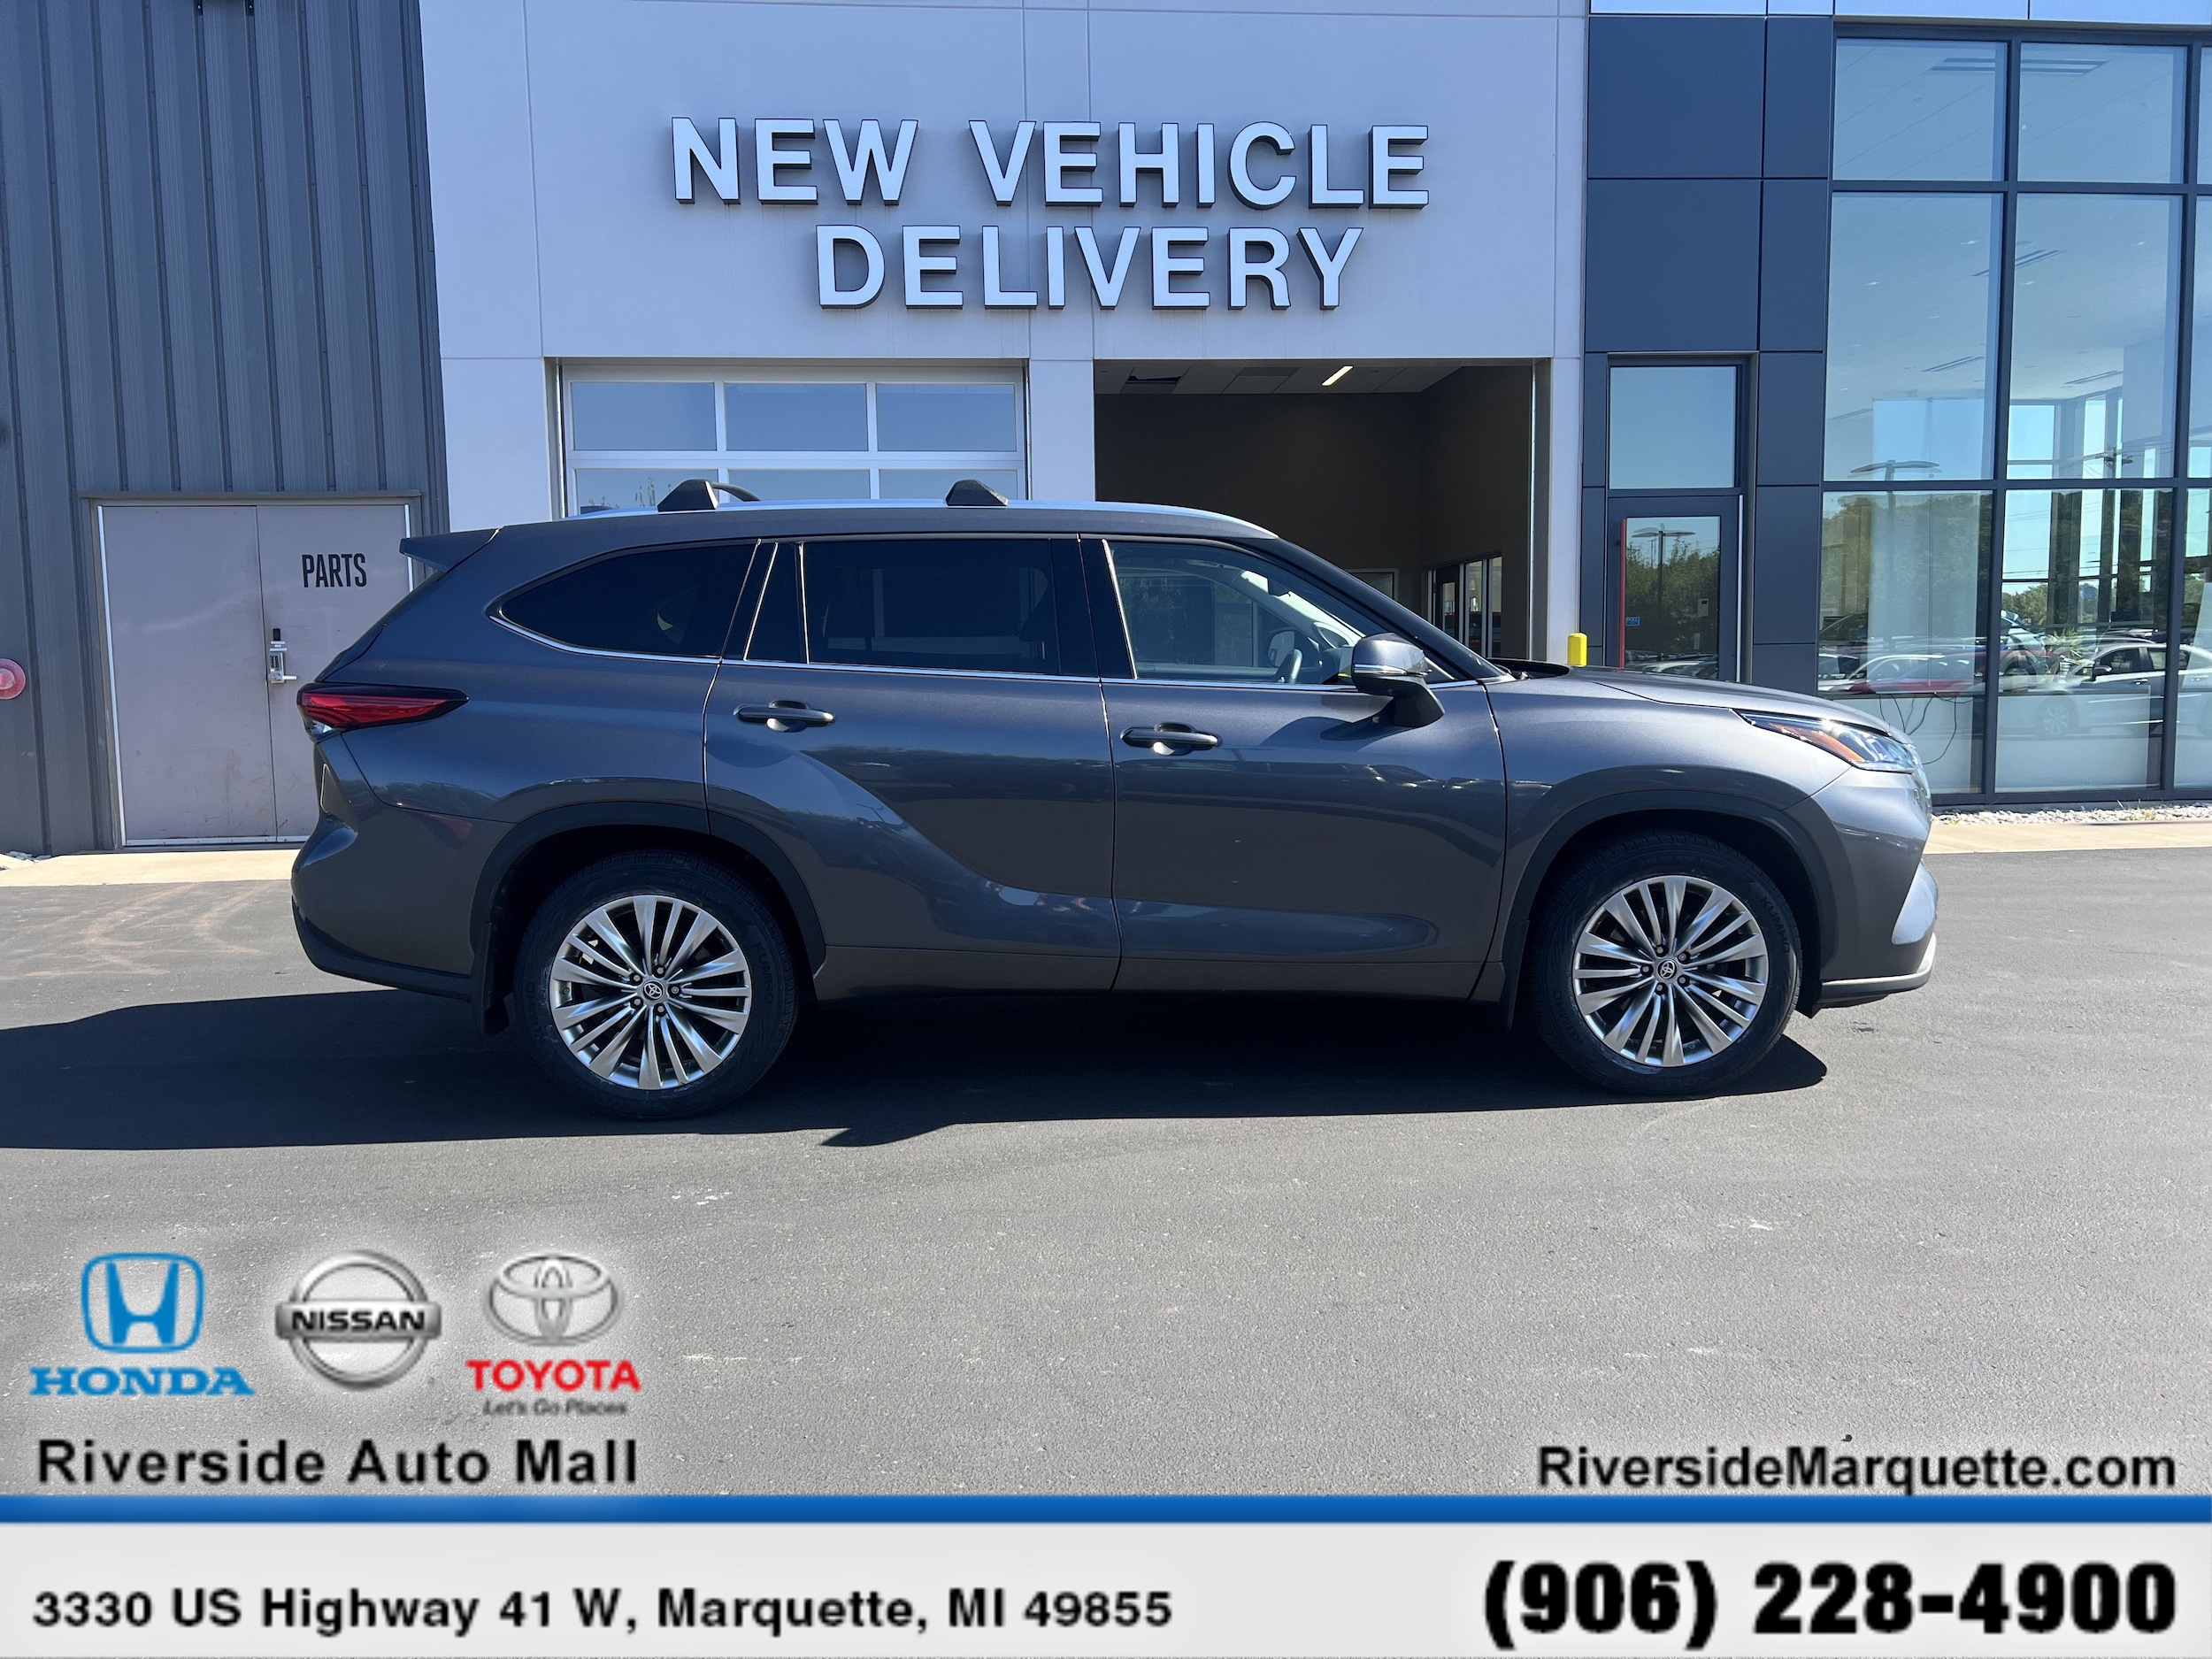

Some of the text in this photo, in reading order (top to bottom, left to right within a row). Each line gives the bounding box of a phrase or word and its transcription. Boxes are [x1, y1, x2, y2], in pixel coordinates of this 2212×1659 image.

[672, 117, 1430, 209] NEW VEHICLE
[816, 224, 1364, 311] DELIVERY
[302, 553, 366, 588] PARTS
[1760, 895, 1790, 954] KUMHO
[753, 941, 774, 1004] KUMHO
[1553, 989, 1585, 1048] KUMHO
